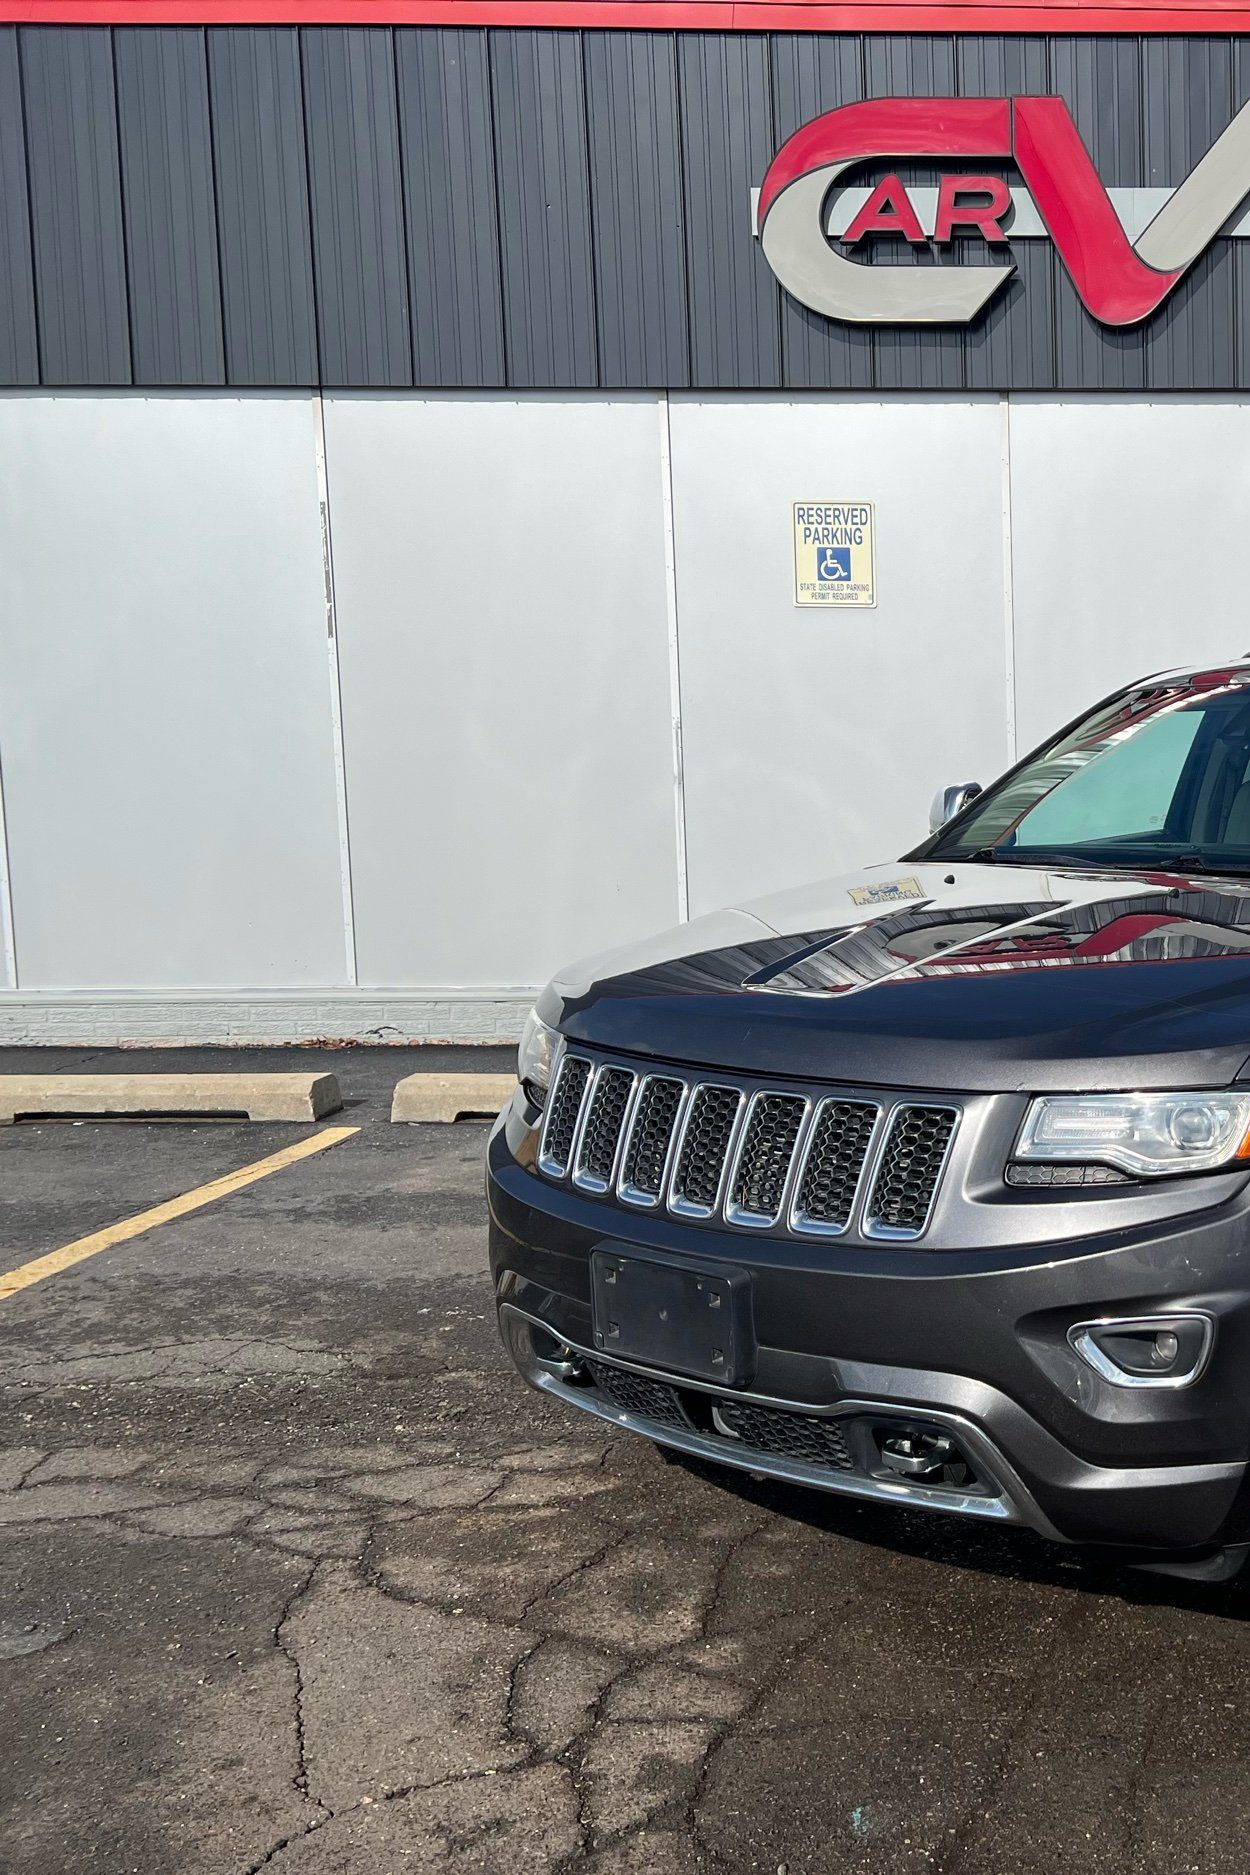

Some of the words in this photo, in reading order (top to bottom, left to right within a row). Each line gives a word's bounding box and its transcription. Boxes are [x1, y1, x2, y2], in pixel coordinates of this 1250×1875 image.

[797, 507, 868, 526] RESERVED
[803, 527, 863, 545] PARKING
[799, 583, 816, 591] STATE
[819, 583, 844, 592] DISABLED
[846, 584, 870, 592] PARKING
[811, 592, 830, 600] PERMIT
[832, 593, 859, 601] REQUIRED
